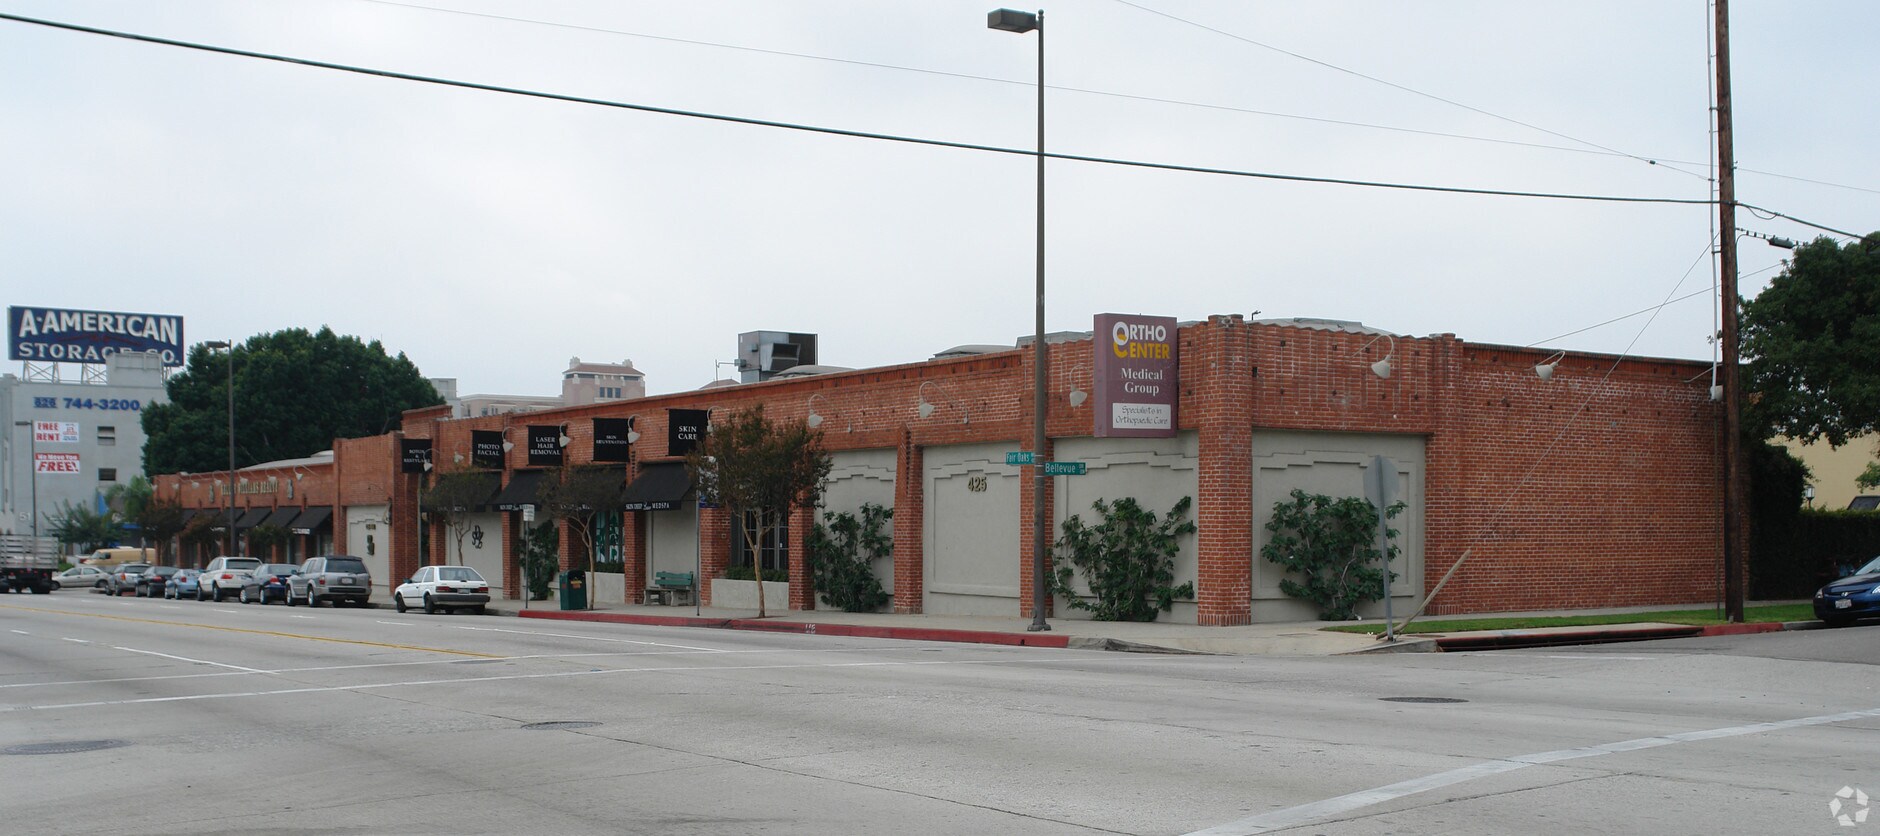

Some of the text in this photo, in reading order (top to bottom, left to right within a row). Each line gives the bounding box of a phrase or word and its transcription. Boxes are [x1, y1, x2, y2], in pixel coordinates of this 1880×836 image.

[1112, 321, 1166, 346] ORTHO
[1112, 335, 1170, 359] CENTER
[1121, 368, 1162, 380] Medical
[1124, 381, 1159, 396] Group
[63, 397, 140, 411] 744-3200
[37, 422, 60, 431] FREE
[36, 433, 60, 441] RENT
[1006, 453, 1016, 461] Fair
[1017, 454, 1030, 462] Oaks
[37, 461, 79, 472] FREE!
[1045, 462, 1076, 473] Bellevue
[968, 476, 988, 492] 425
